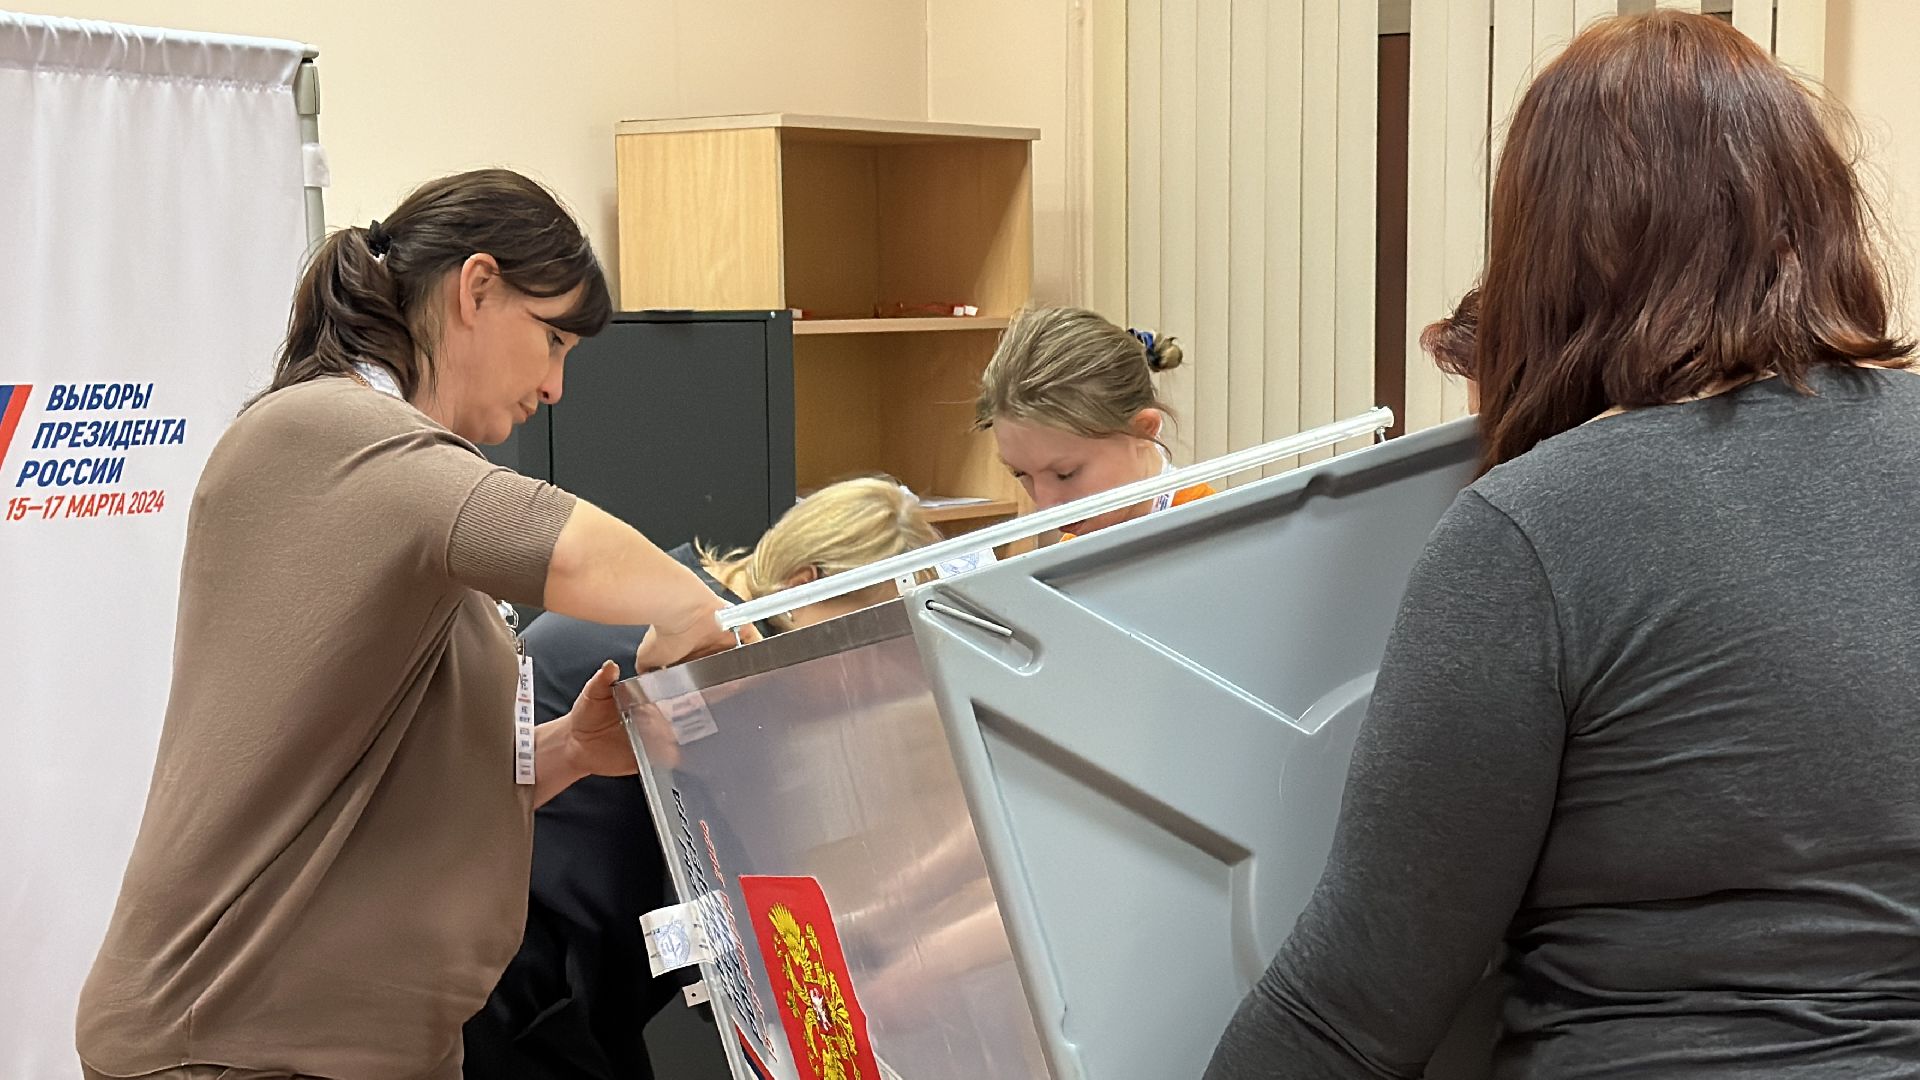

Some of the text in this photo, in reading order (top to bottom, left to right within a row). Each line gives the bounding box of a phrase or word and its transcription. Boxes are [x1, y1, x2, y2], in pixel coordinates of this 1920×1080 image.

[46, 383, 153, 411] ВЫБОРЫ
[32, 419, 186, 450] ПРЕЗИДЕНТА
[16, 457, 125, 487] РОССИИ
[65, 493, 125, 518] МАРТА
[127, 490, 165, 514] 2024
